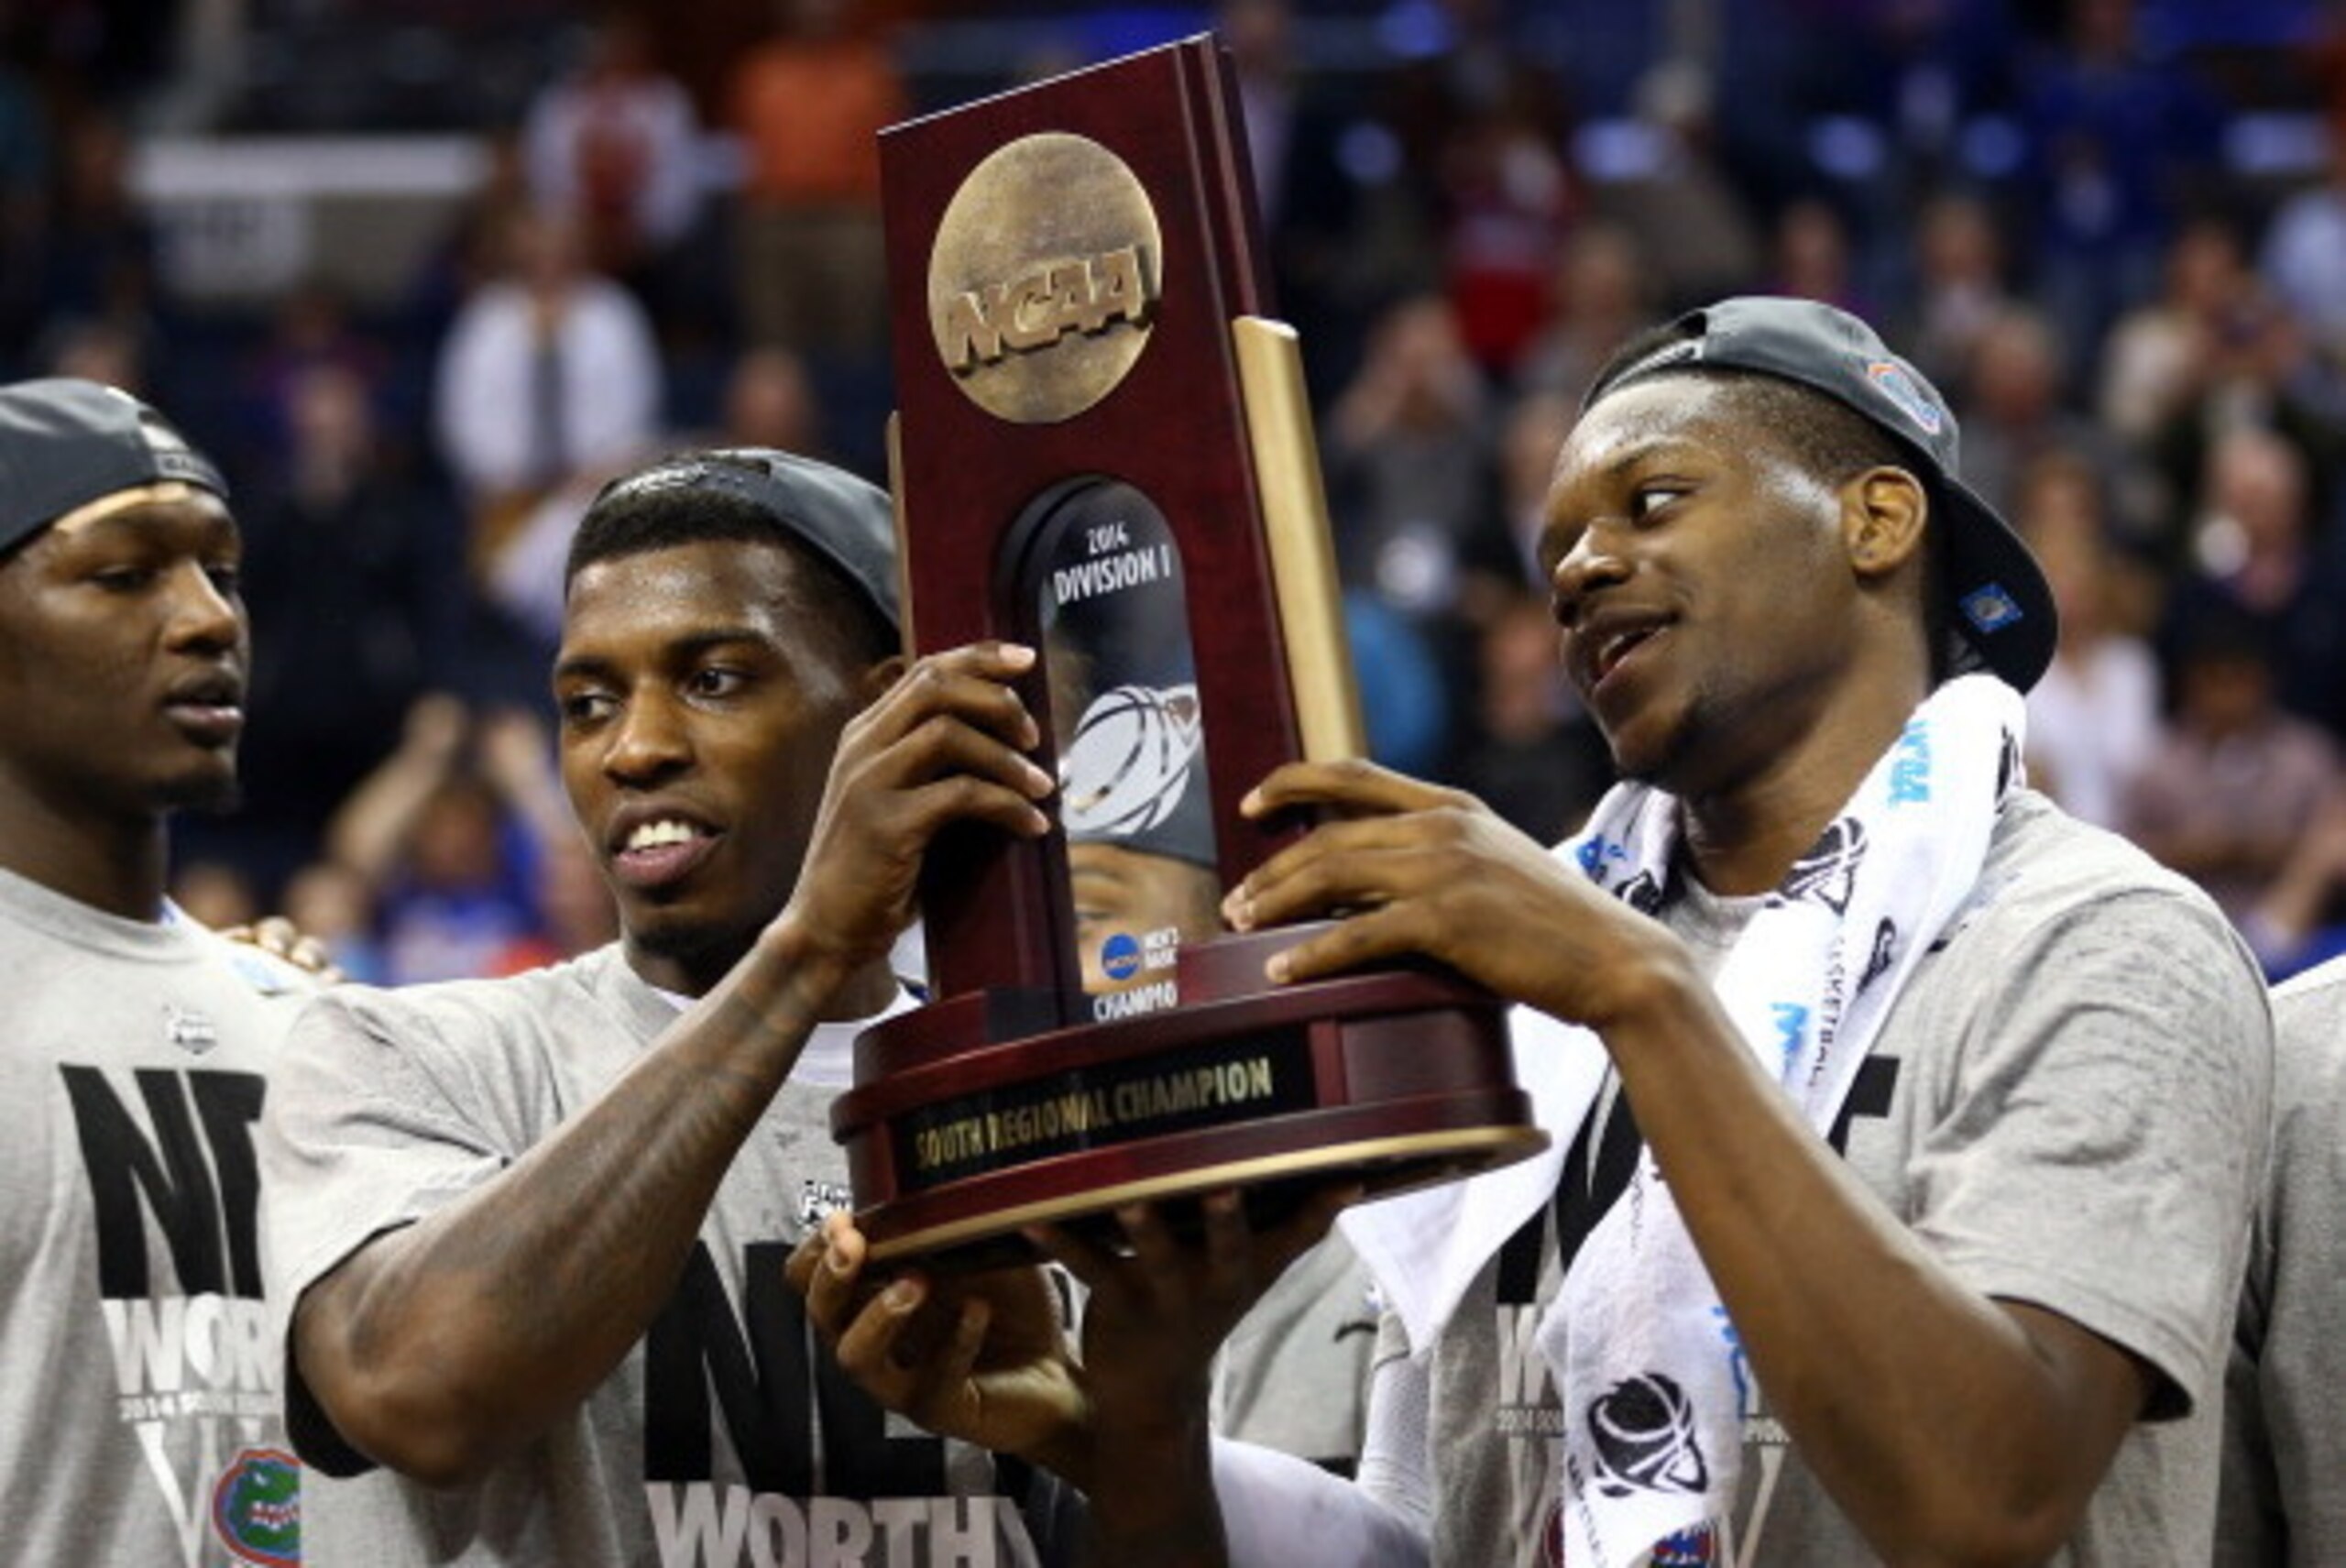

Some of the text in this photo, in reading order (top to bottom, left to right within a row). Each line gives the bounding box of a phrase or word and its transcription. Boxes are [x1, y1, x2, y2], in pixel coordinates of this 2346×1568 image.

[948, 245, 1145, 368] NCAA
[1054, 543, 1170, 605] DIVISION I
[1086, 521, 1129, 555] 2014
[917, 1057, 1272, 1168] SOUTH REGIONAL CHAMPION
